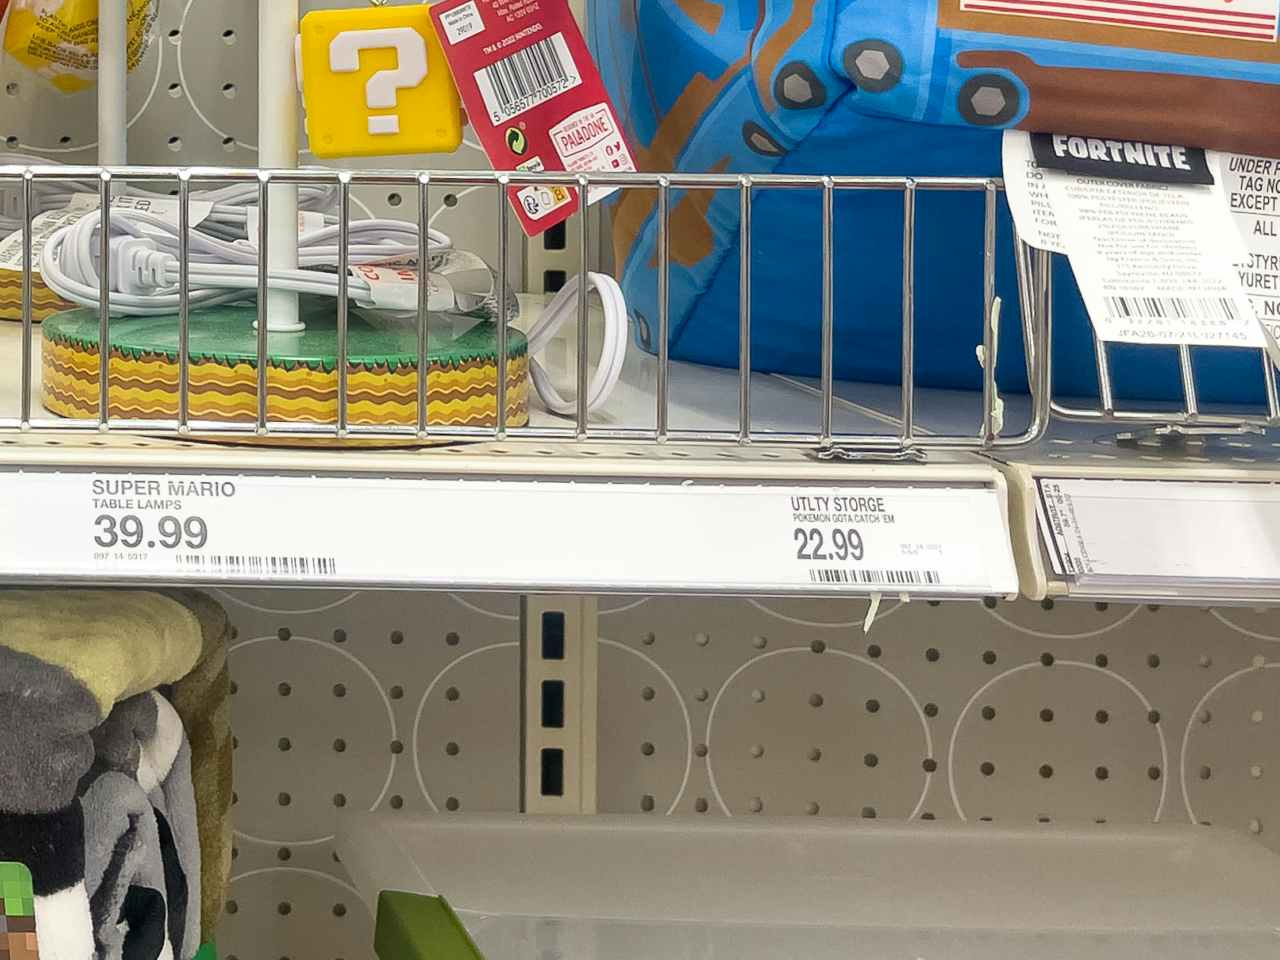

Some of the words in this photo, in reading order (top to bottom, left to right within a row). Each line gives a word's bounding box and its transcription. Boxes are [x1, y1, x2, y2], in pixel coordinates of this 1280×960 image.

[560, 118, 610, 152] PALADONE
[1053, 134, 1192, 171] FORTNITE
[1229, 157, 1272, 176] UNDER
[1239, 175, 1263, 191] TAG
[1230, 192, 1278, 212] EXCEPT
[1253, 219, 1278, 236] ALL
[92, 479, 161, 495] SUPER
[168, 480, 236, 497] MARIO
[92, 498, 134, 509] TABLE
[137, 499, 182, 510] LAMPS
[791, 496, 830, 512] UTLTY
[834, 497, 886, 513] STORGE
[793, 513, 831, 523] POKEMON
[831, 514, 854, 523] GOTA
[854, 514, 880, 523] CATCH
[93, 514, 208, 549] 39.99
[794, 528, 864, 561] 22.99
